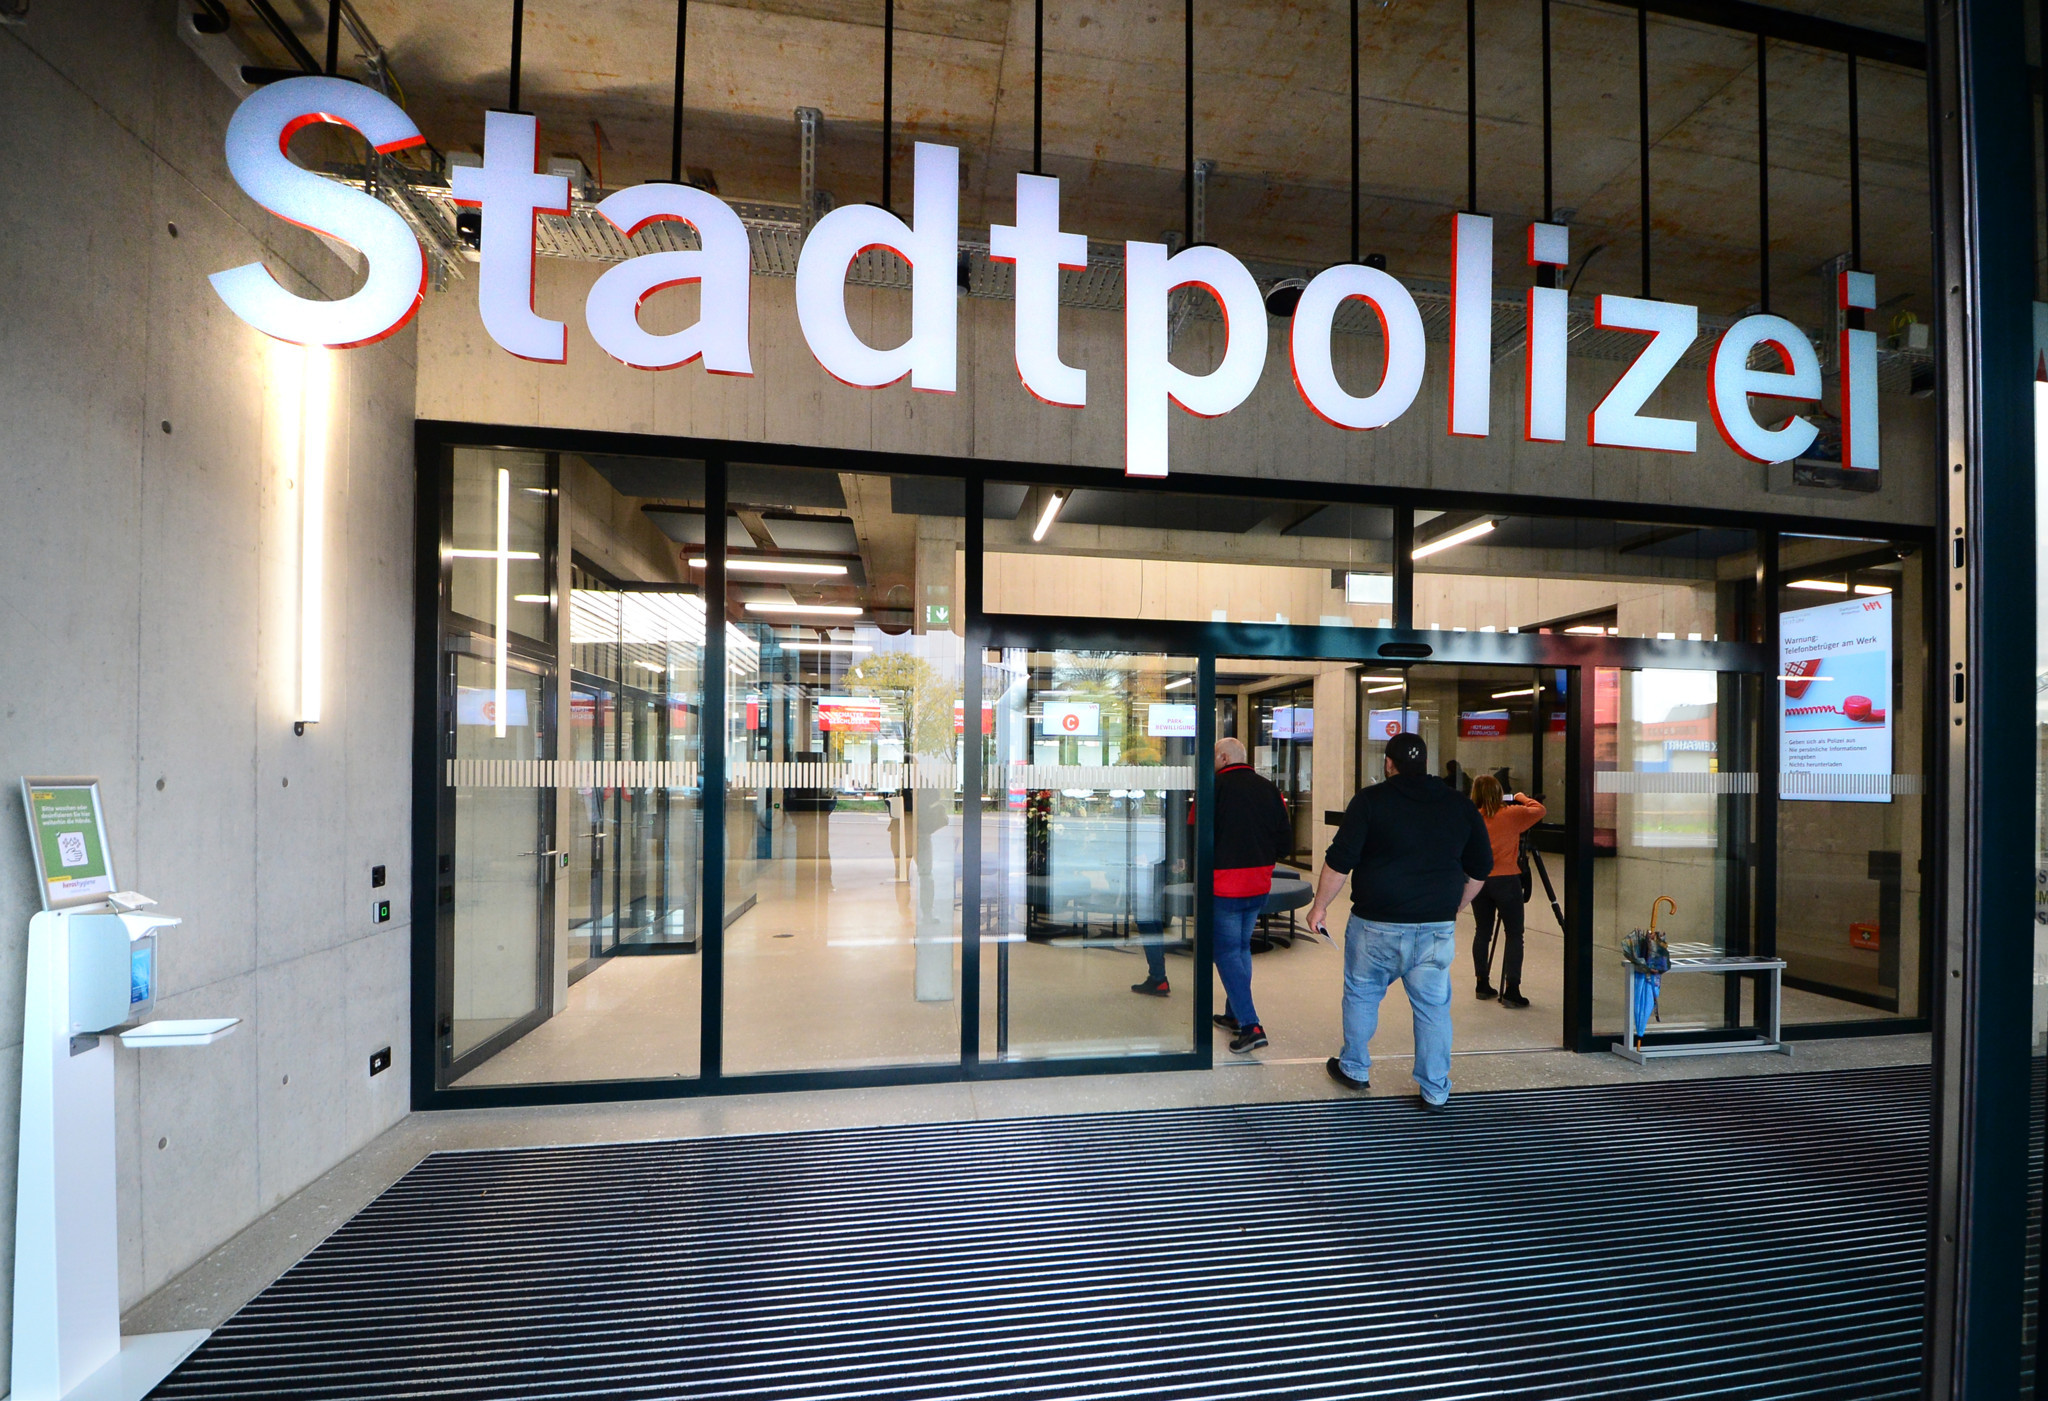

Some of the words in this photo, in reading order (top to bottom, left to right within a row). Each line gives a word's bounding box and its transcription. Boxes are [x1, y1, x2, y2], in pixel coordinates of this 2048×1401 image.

[208, 75, 1880, 479] Stadtpolizei
[1784, 635, 1818, 645] Warnung:
[1784, 642, 1840, 655] Telefonbetrüger
[1856, 636, 1877, 645] Werk
[1066, 717, 1075, 729] C
